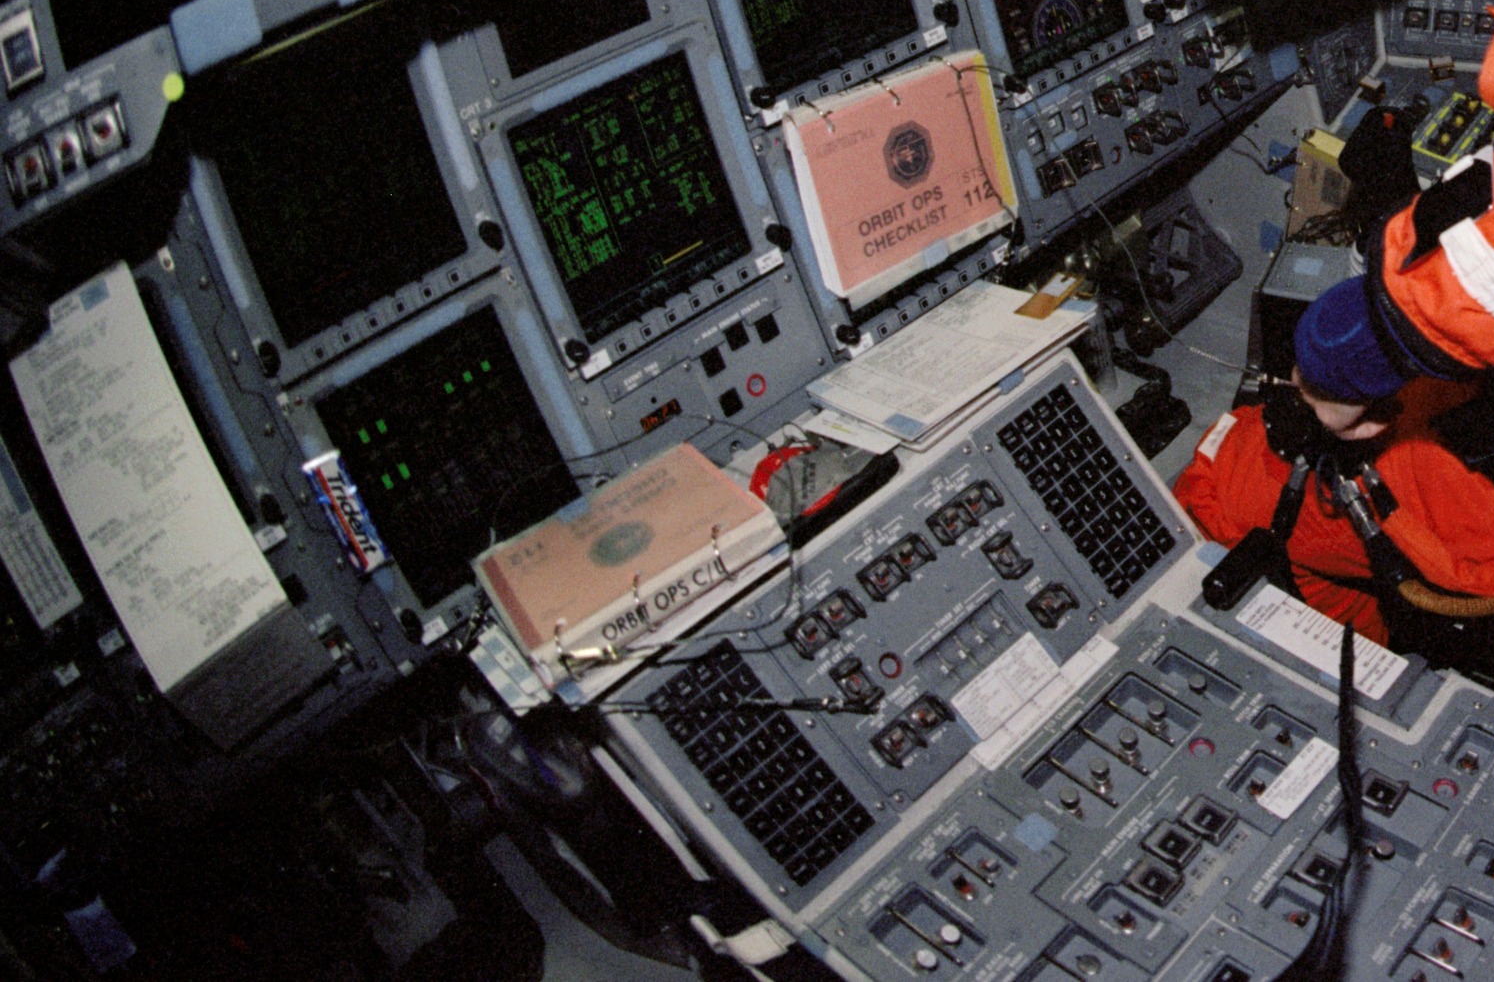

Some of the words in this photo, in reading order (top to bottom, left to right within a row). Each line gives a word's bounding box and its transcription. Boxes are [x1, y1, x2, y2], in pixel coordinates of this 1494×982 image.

[962, 167, 985, 184] STS
[964, 179, 994, 207] 112
[858, 202, 906, 237] ORBIT
[913, 186, 943, 211] OPS
[863, 205, 948, 258] CHECKLIST
[327, 470, 377, 554] Trident
[602, 604, 650, 641] ORBIT
[654, 578, 690, 611] OPS
